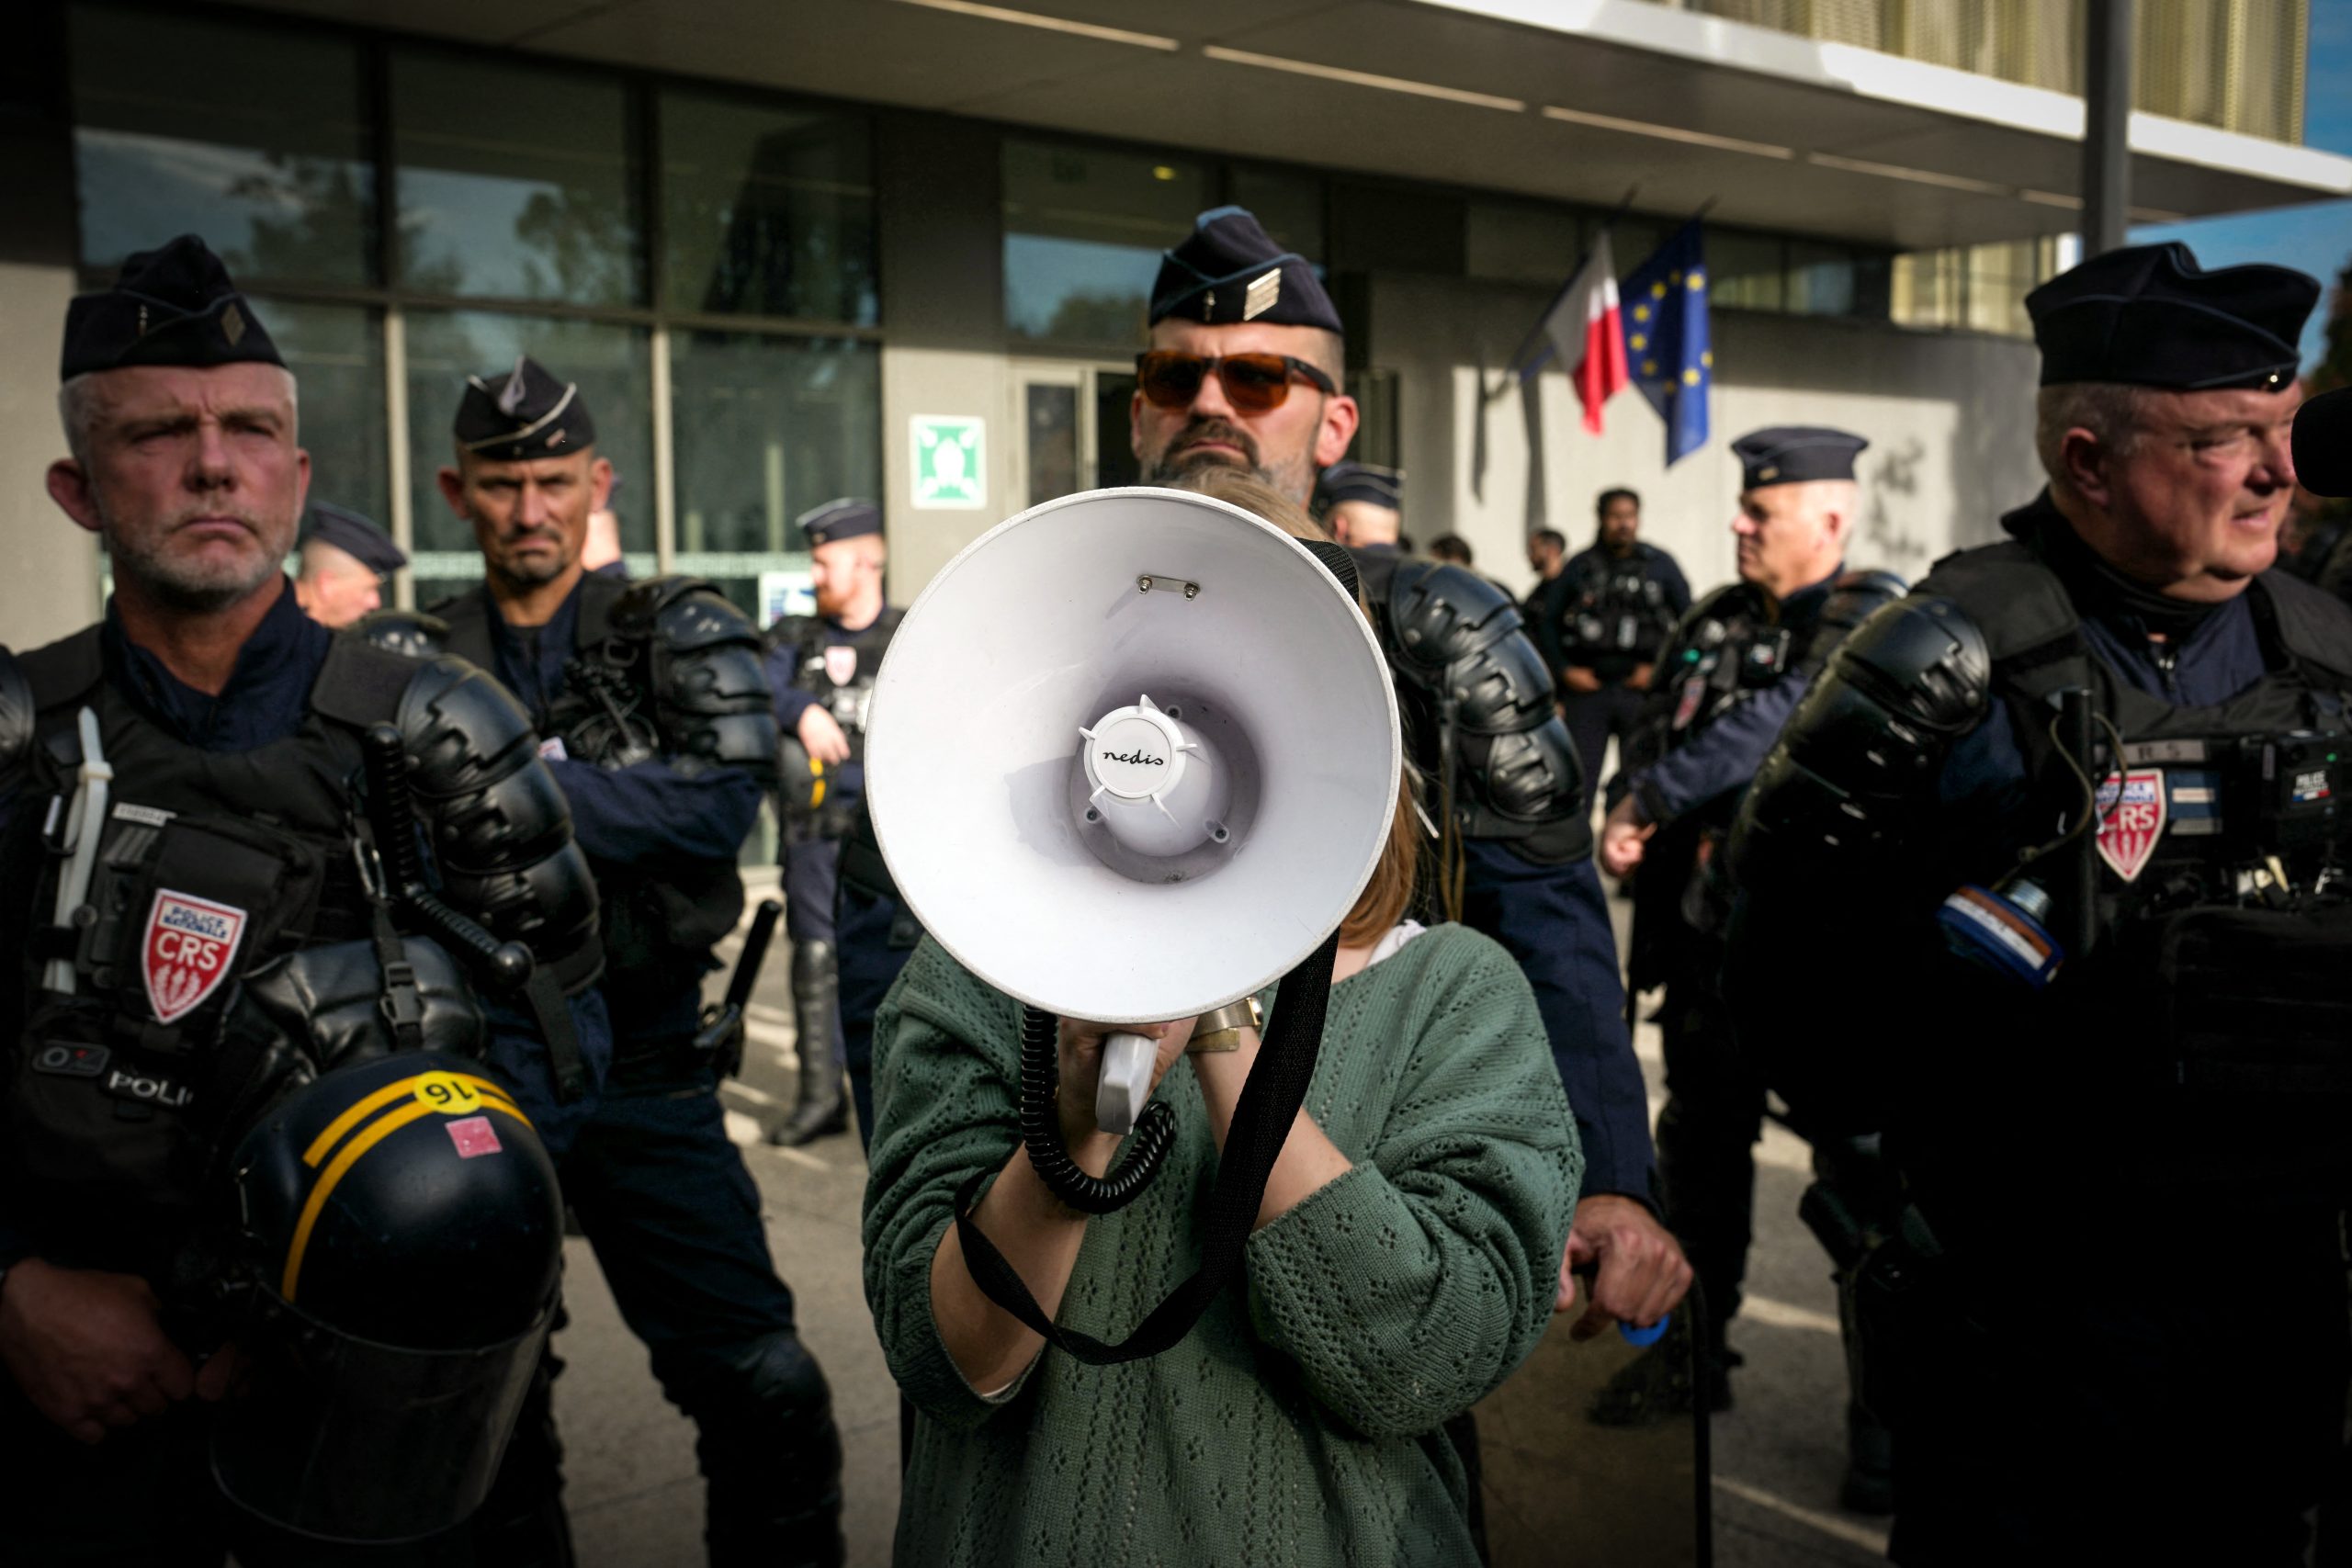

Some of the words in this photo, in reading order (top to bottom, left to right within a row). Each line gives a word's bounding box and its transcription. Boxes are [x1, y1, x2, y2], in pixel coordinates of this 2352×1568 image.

[1102, 749, 1163, 766] nedis
[172, 906, 224, 928] POLICE
[155, 931, 221, 972] CRS
[425, 1081, 473, 1104] 16
